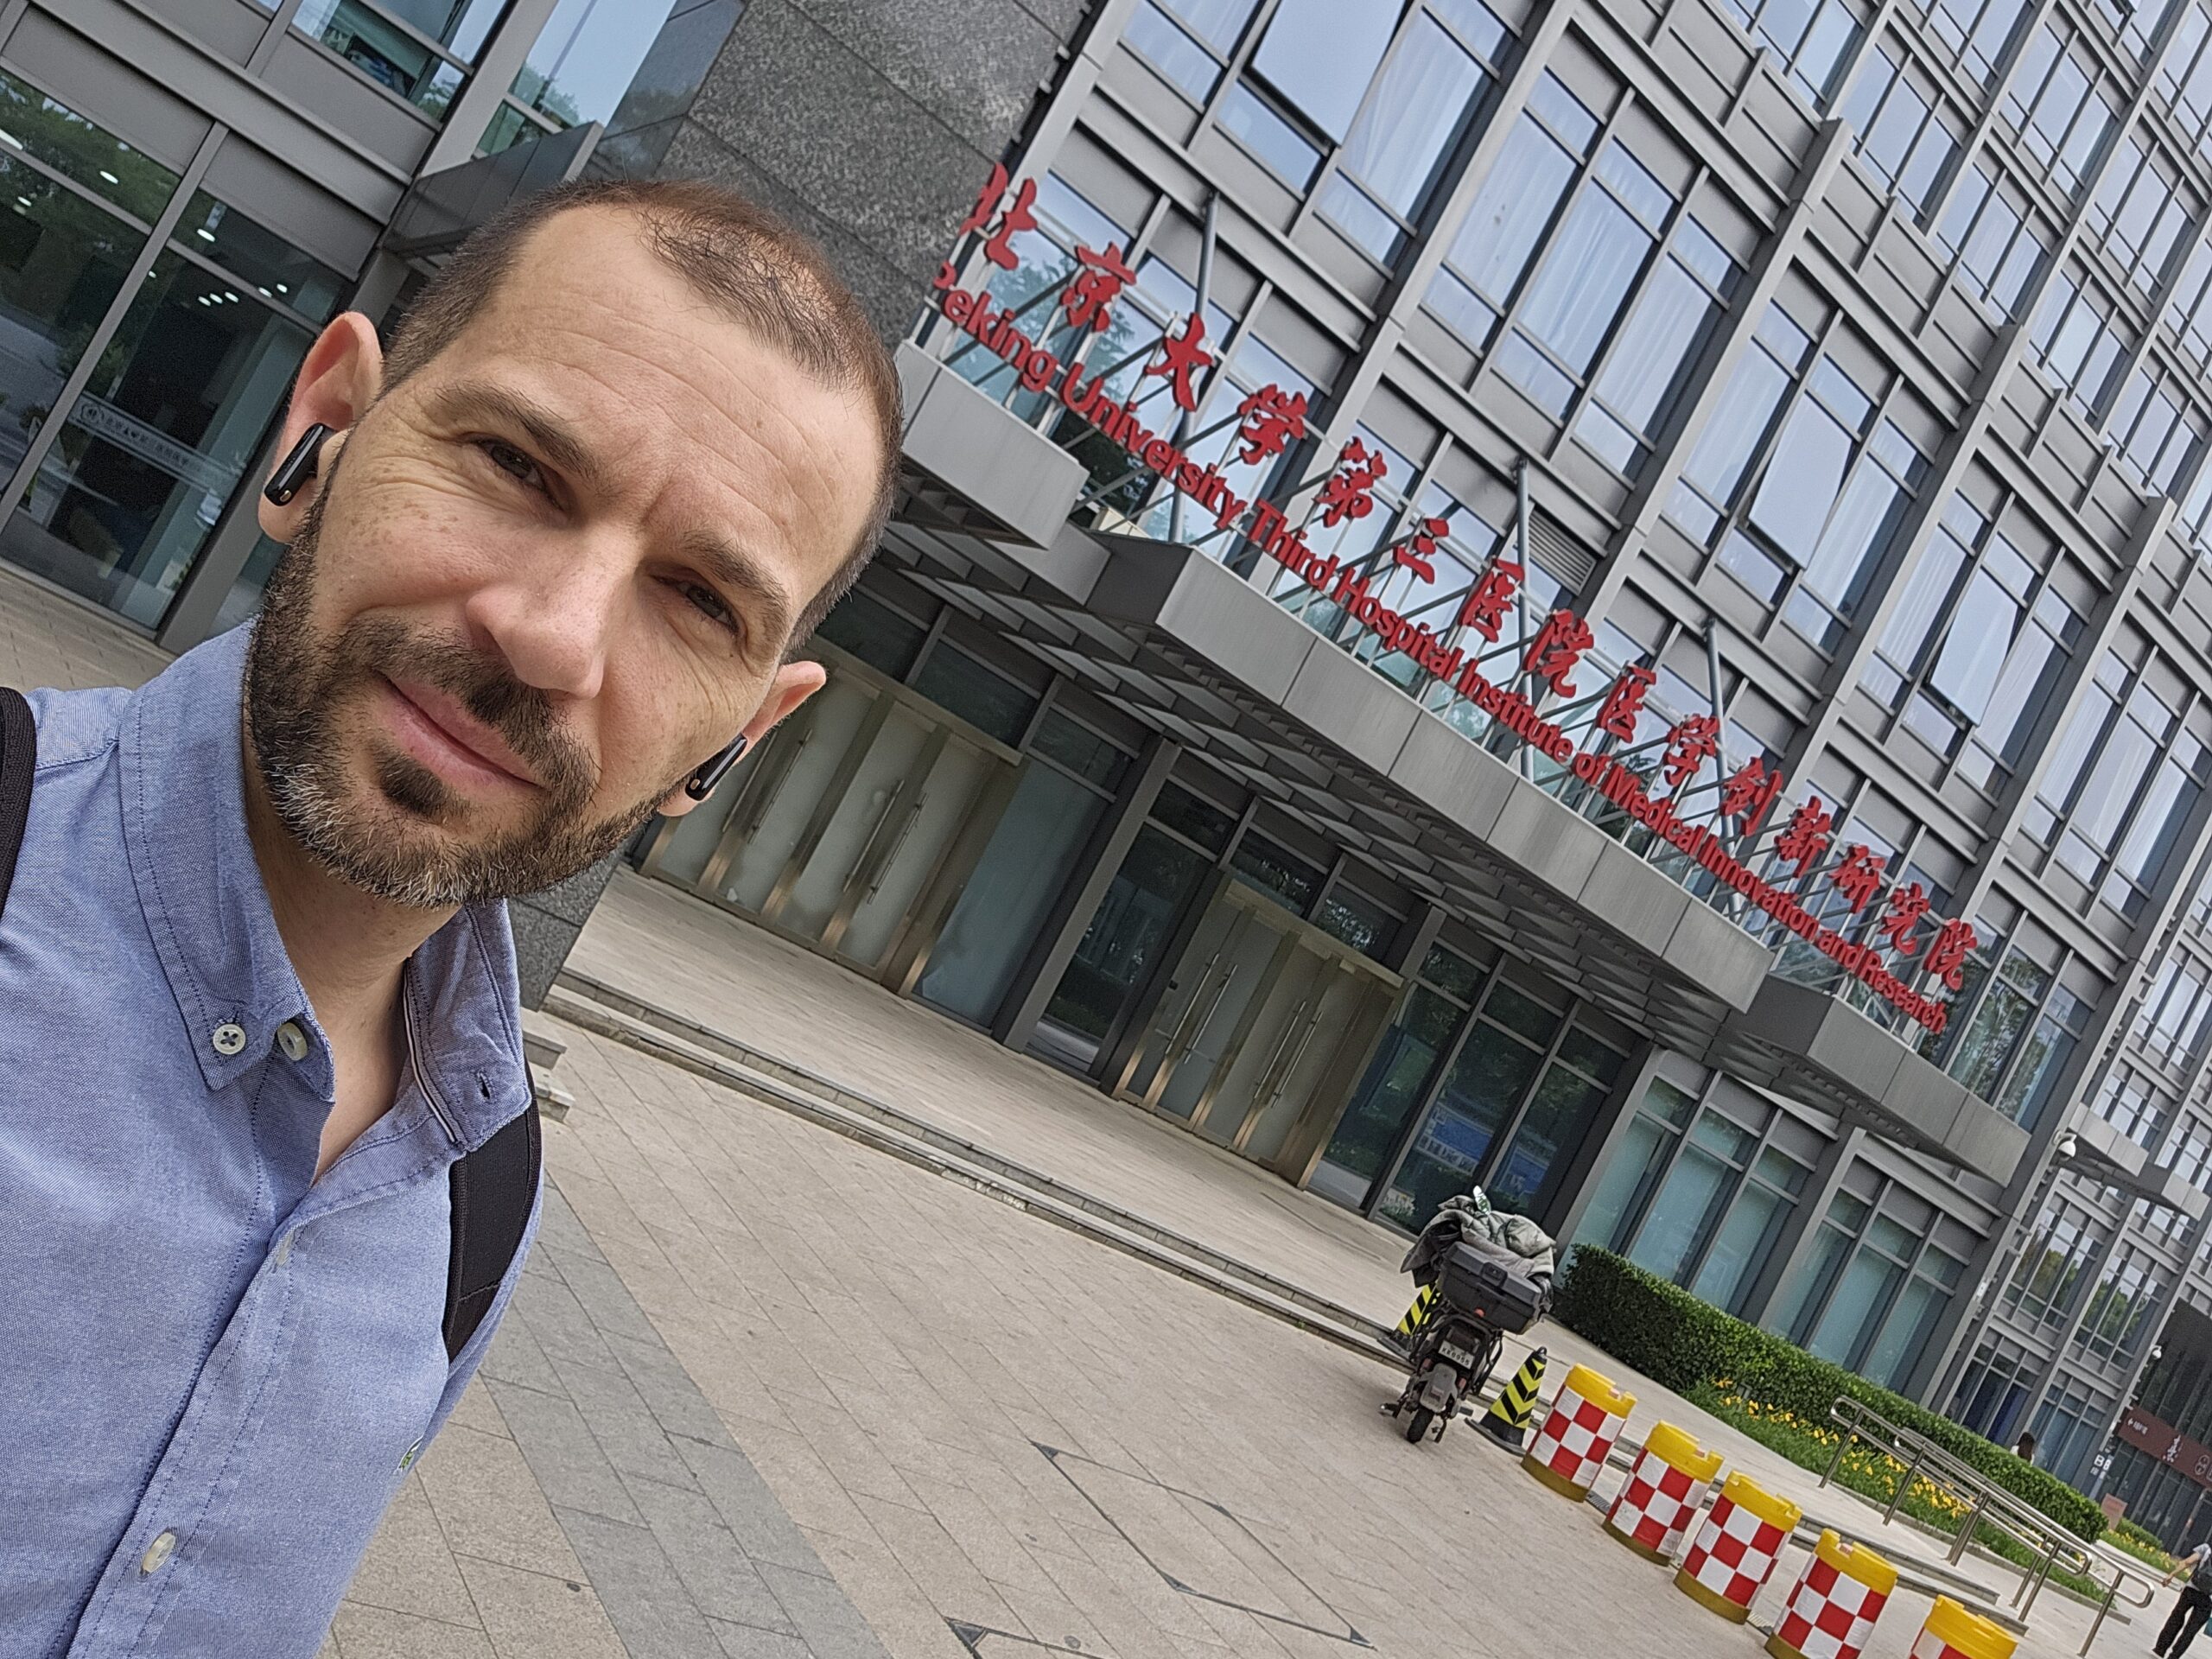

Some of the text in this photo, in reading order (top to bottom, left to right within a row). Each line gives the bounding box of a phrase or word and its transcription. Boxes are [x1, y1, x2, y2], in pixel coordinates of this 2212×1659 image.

[958, 162, 1978, 991] 北京大学第三医院医学创新研究院
[1061, 363, 1248, 530] University
[1248, 499, 1340, 592] Third
[1332, 567, 1465, 682] Hospital
[1456, 658, 1574, 762] Institute
[1574, 752, 1615, 786] of
[1603, 764, 1708, 857] Medical
[1696, 835, 1821, 942] Innovation
[1817, 930, 1866, 973] and
[1853, 950, 1947, 1034] Research
